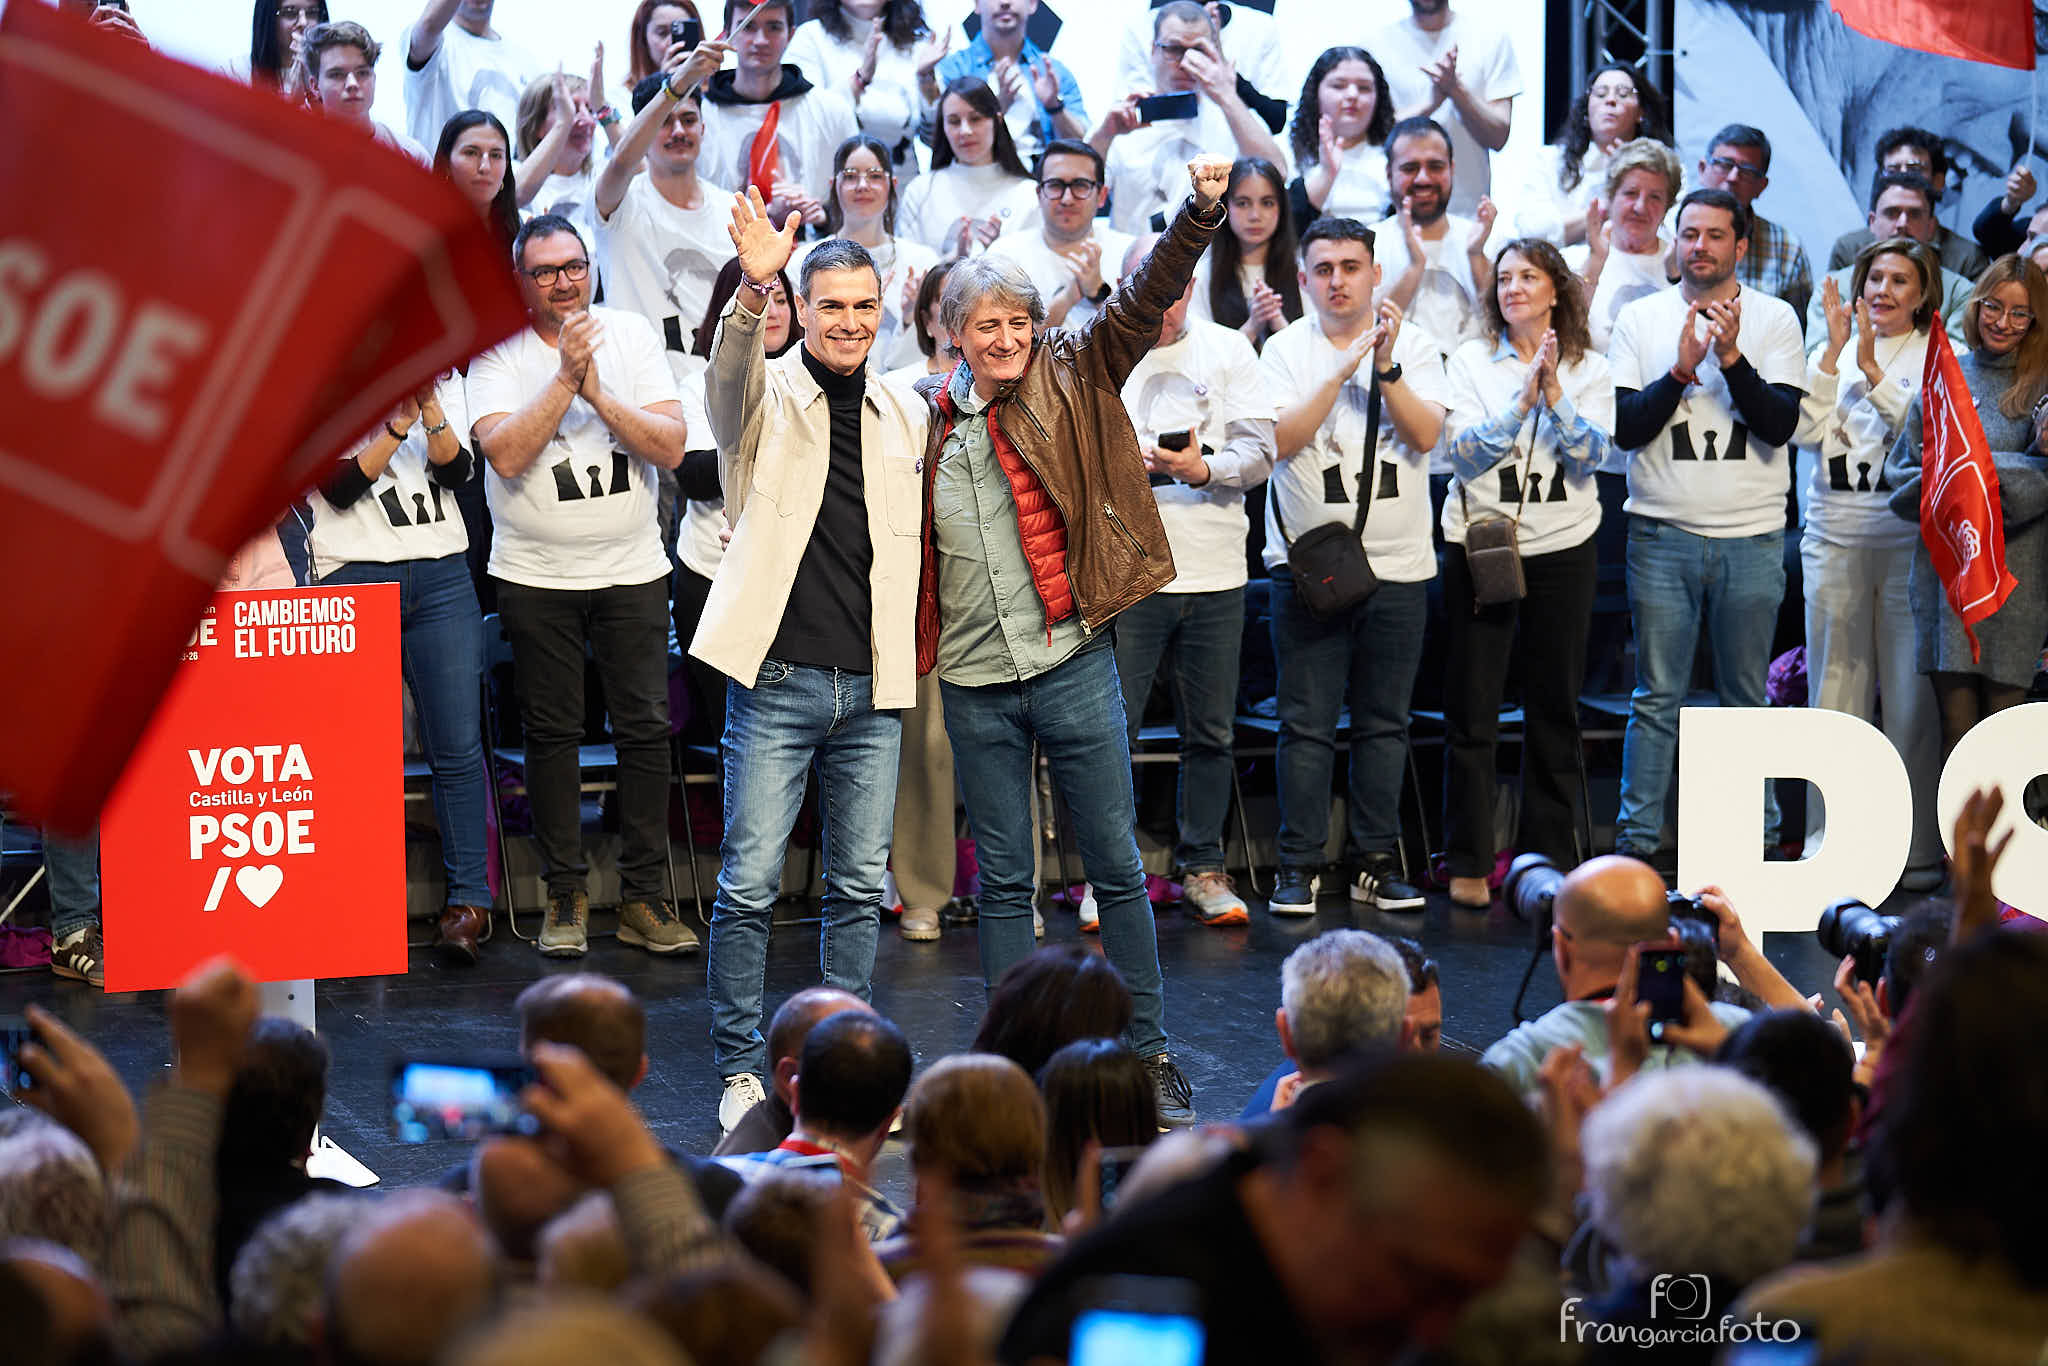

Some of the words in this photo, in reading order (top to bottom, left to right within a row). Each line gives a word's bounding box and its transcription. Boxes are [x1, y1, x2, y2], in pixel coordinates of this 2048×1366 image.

[234, 596, 356, 627] CAMBIEMOS
[234, 628, 262, 658] EL
[268, 624, 356, 657] FUTURO
[187, 743, 314, 786] VOTA
[189, 789, 254, 807] Castilla
[258, 791, 267, 807] y
[272, 785, 313, 803] León
[189, 809, 316, 860] PSOE
